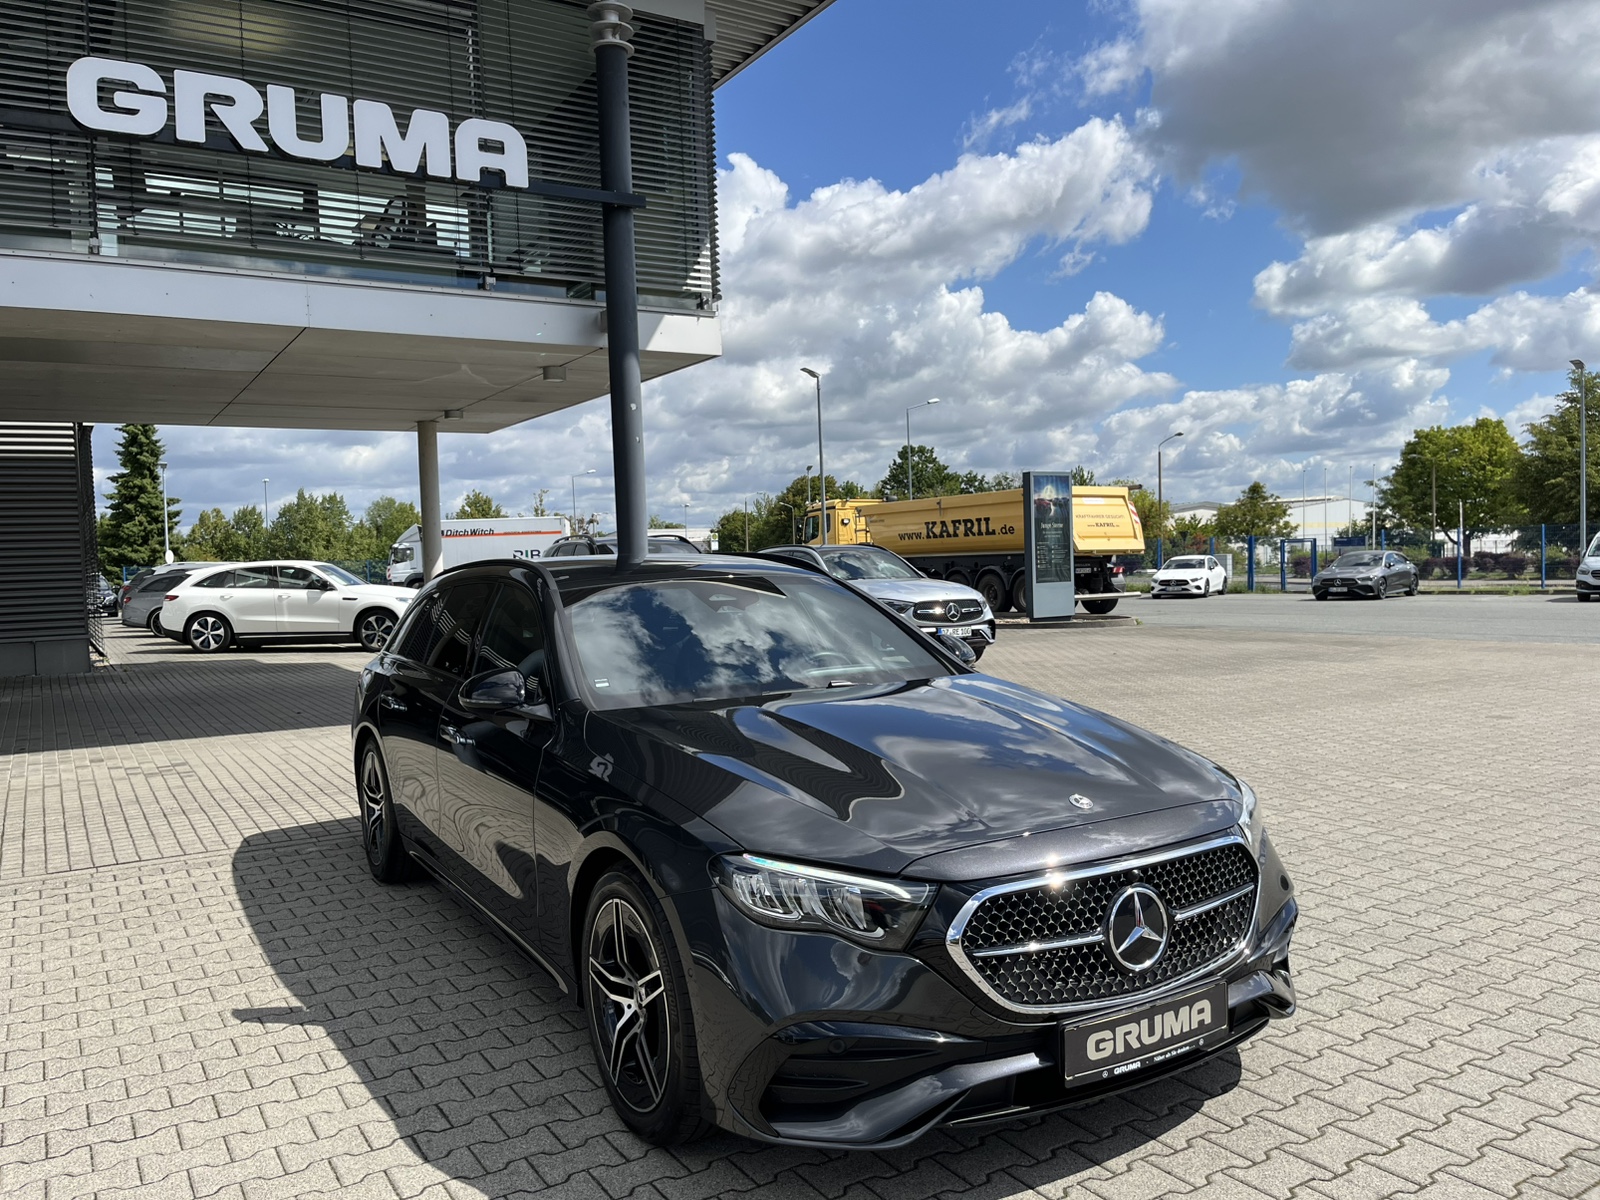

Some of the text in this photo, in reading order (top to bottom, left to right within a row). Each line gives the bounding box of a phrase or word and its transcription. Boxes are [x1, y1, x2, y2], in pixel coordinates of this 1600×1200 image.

[66, 57, 529, 189] GRUMA
[1087, 999, 1211, 1061] GRUMA
[1114, 1061, 1141, 1074] GRUMA
